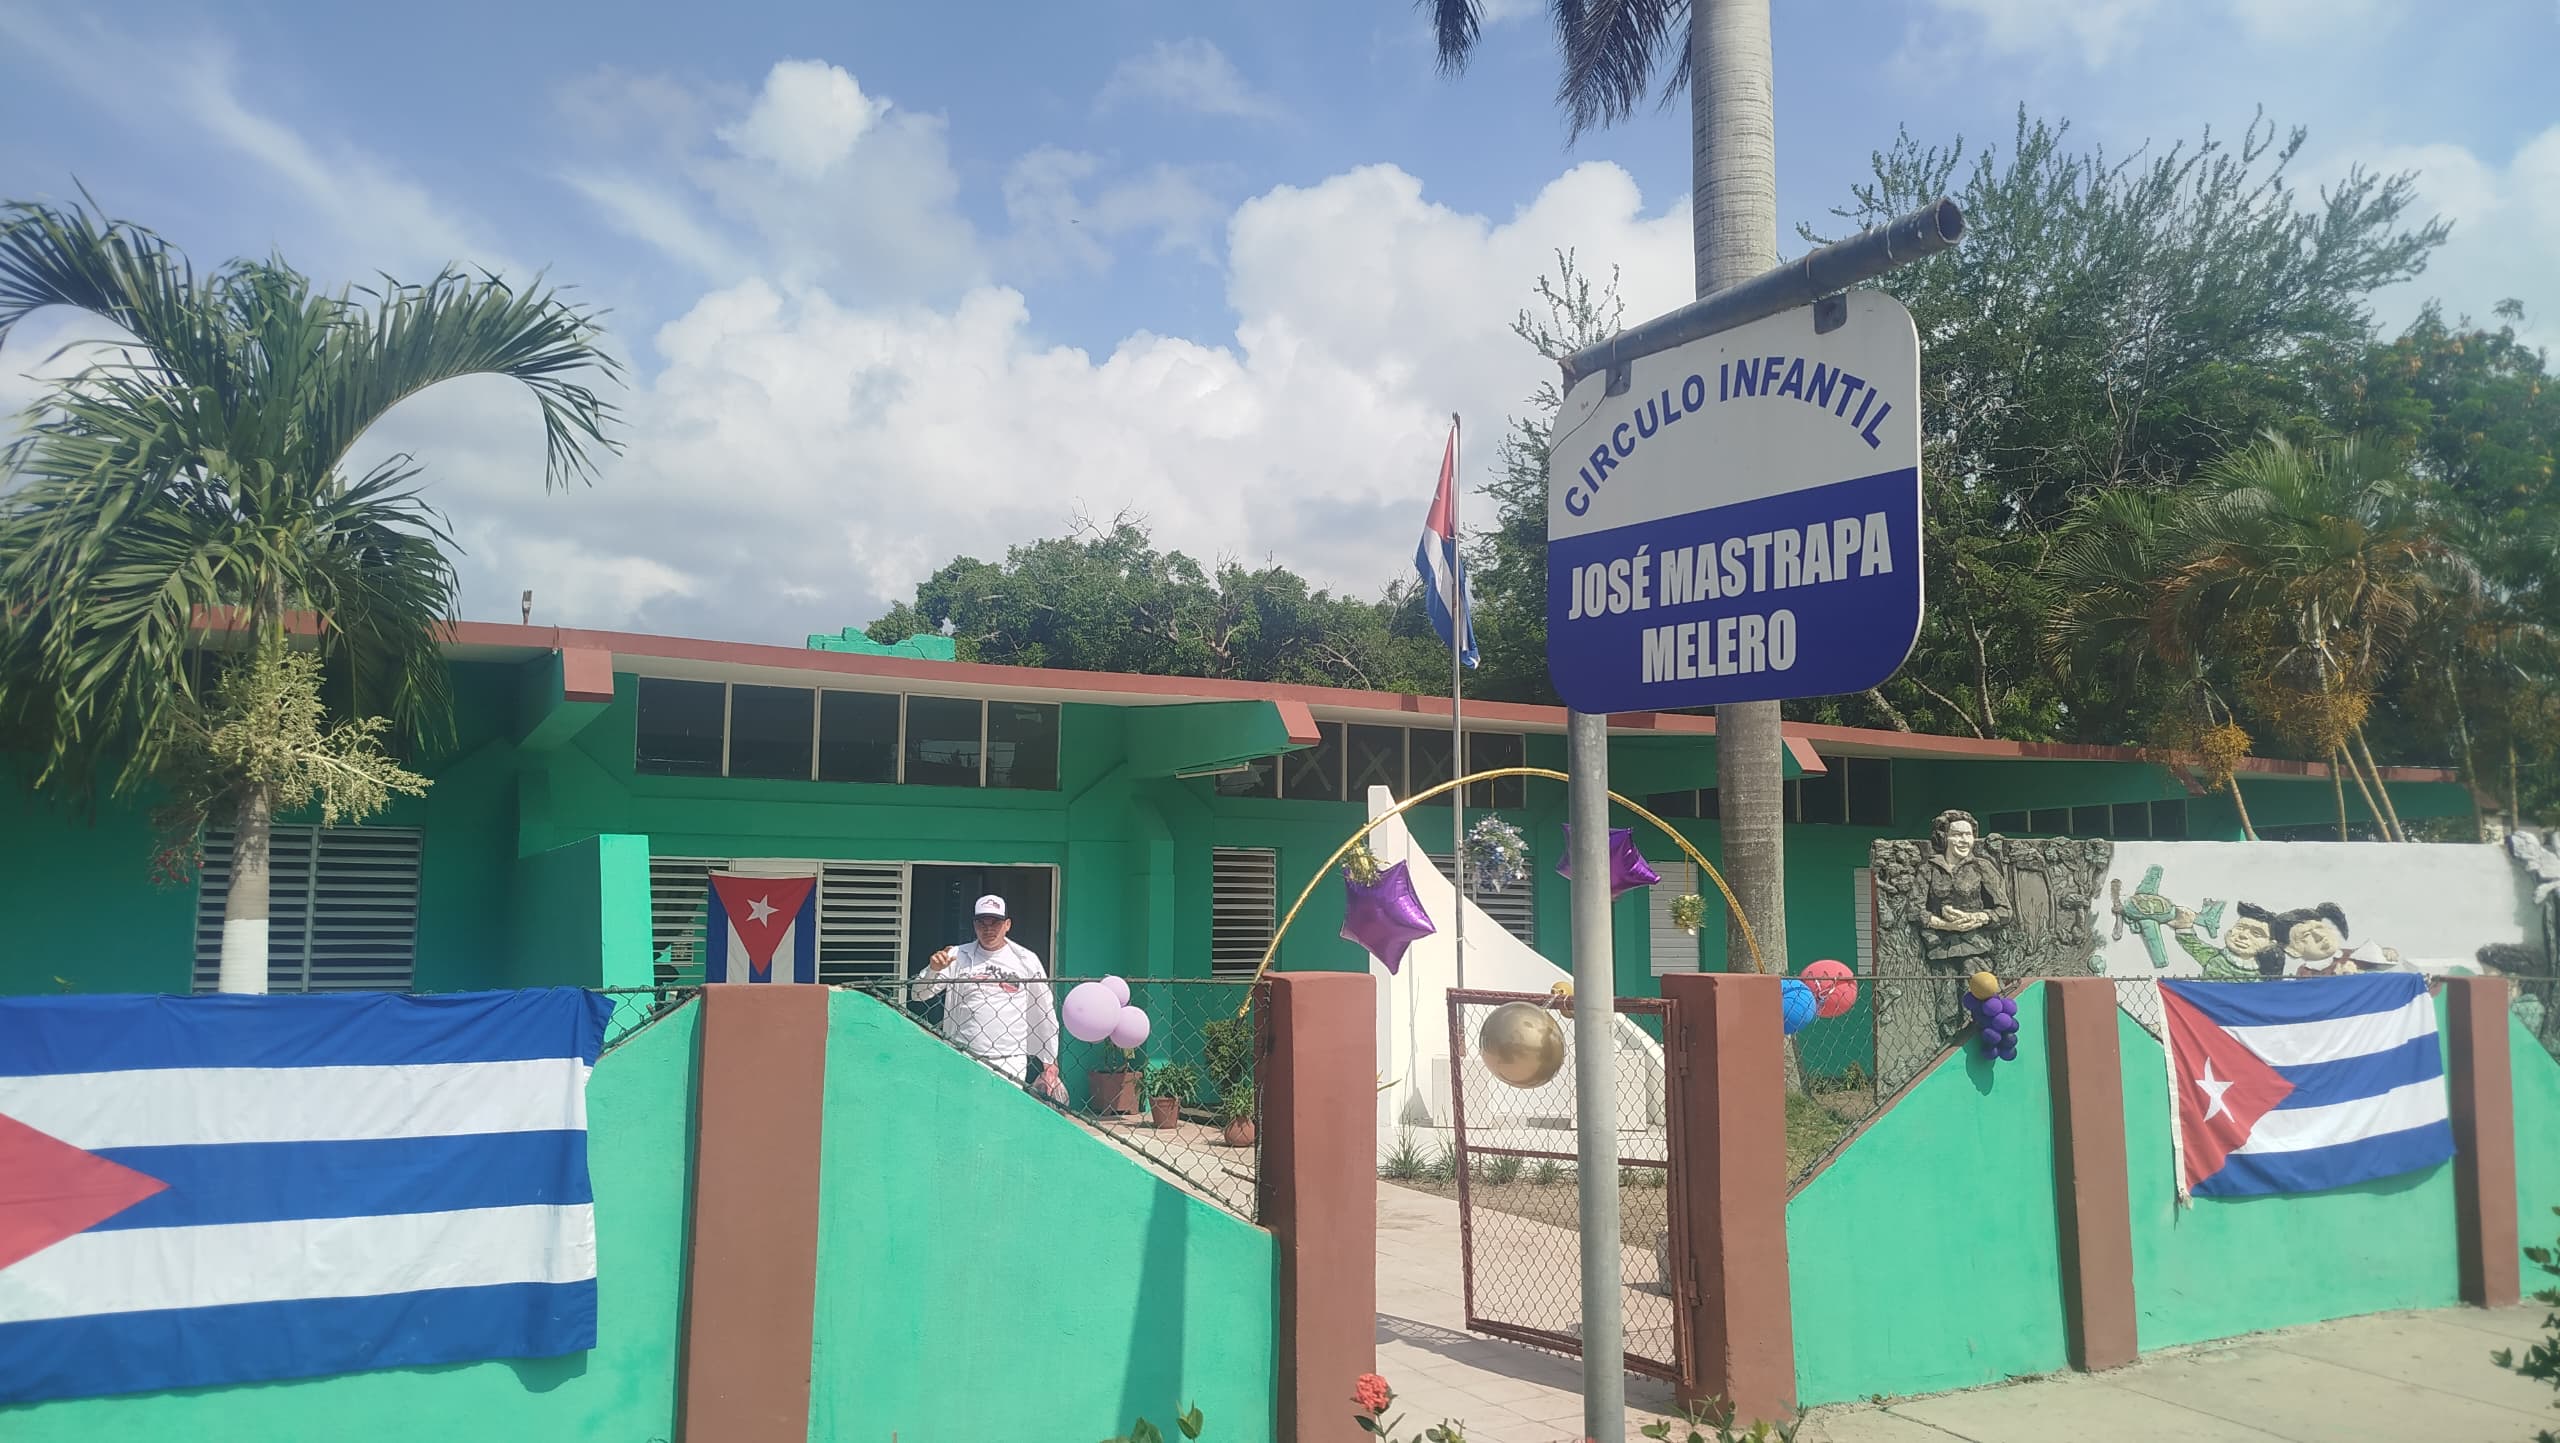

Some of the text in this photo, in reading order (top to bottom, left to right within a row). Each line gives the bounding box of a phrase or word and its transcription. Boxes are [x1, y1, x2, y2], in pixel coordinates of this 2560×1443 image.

[1564, 356, 1893, 518] CIRCULO INFANTIL
[1568, 510, 1893, 621] JOSÉ MASTRAPA
[1641, 609, 1797, 684] MELERO
